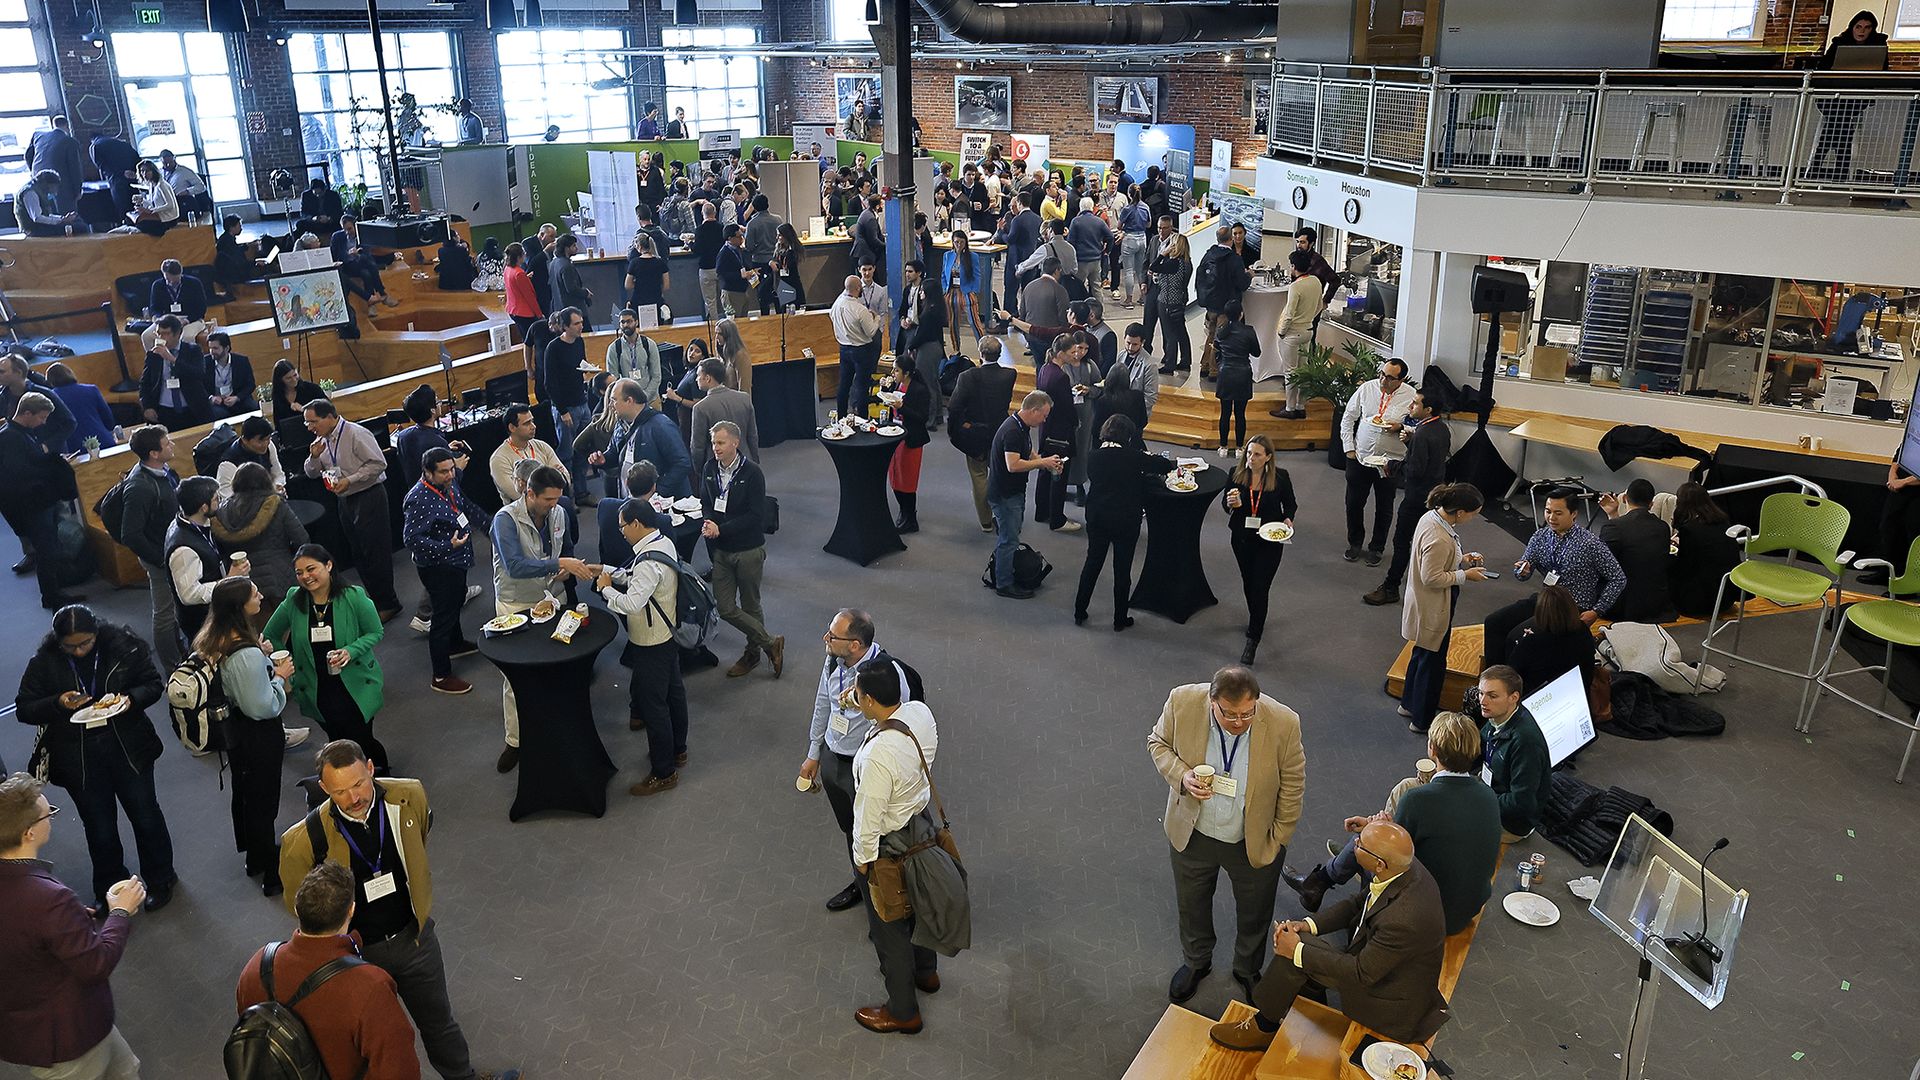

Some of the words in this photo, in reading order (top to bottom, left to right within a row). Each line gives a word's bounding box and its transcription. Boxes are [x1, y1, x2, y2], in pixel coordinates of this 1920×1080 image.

[141, 10, 160, 23] EXIT
[1287, 170, 1318, 186] Somerville
[1341, 181, 1371, 198] Houston
[1530, 692, 1552, 712] Agenda
